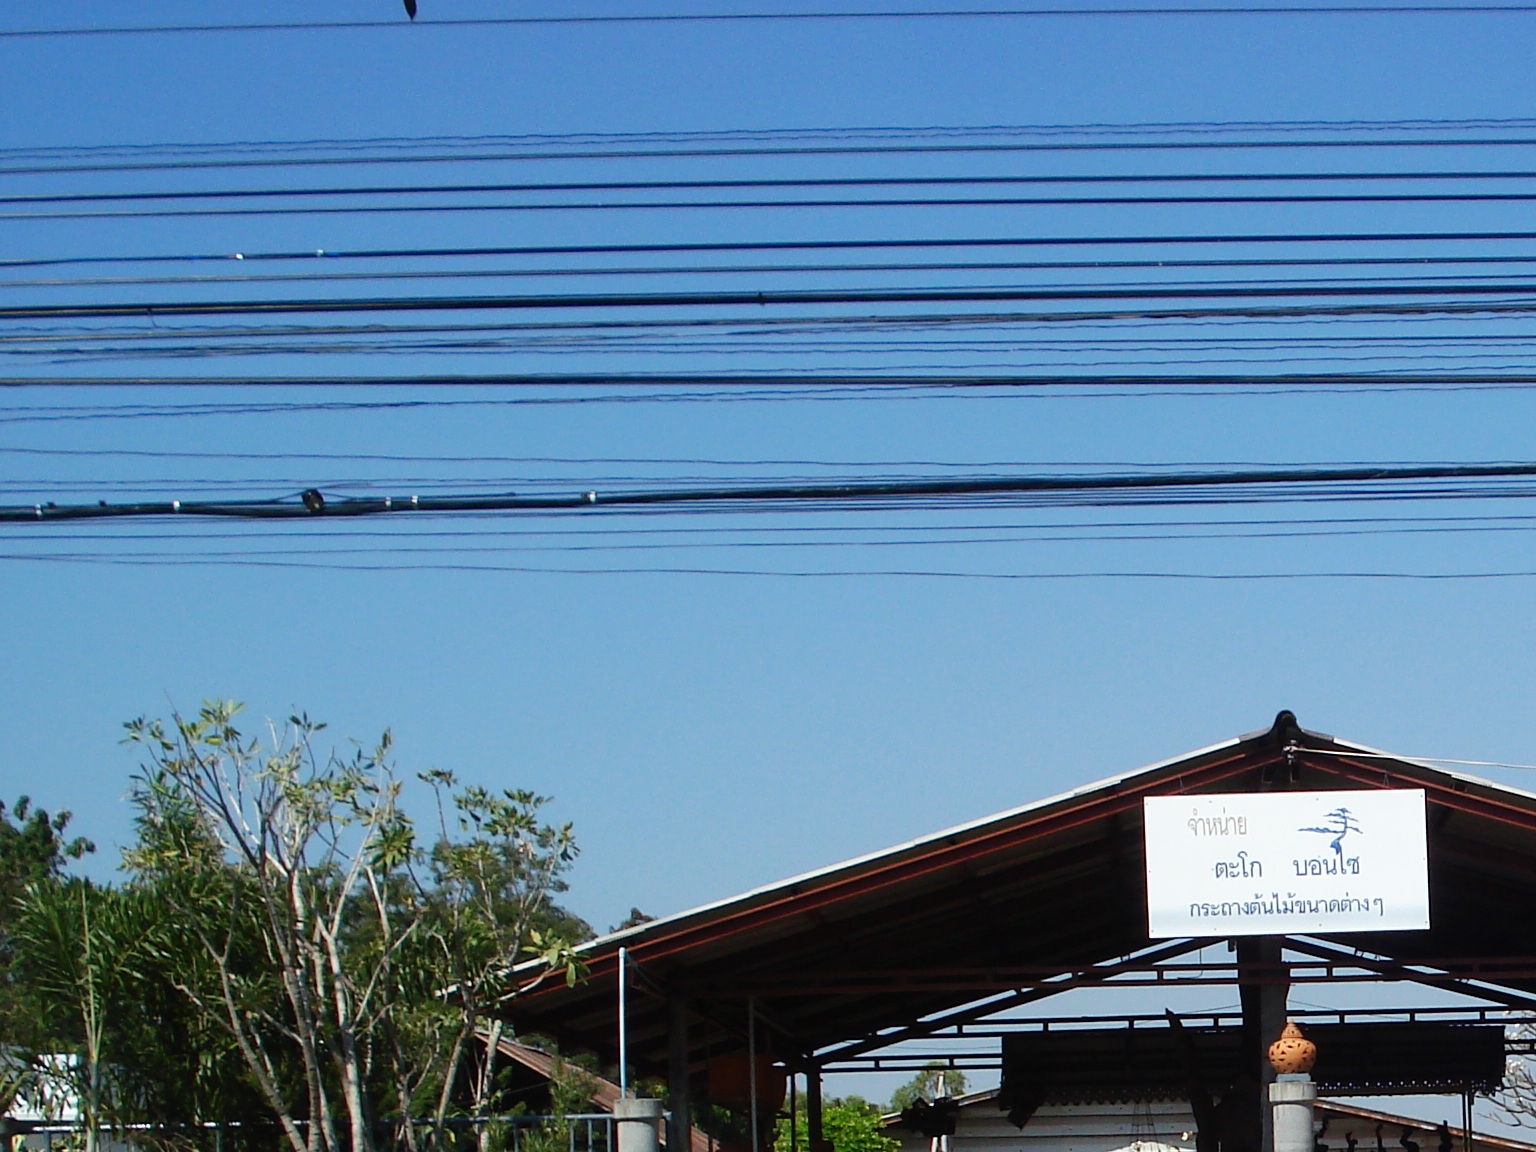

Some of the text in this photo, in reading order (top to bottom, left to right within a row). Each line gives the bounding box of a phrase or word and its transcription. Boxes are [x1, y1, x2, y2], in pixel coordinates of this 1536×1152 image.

[1187, 806, 1247, 836] จำหน่าย
[1215, 850, 1262, 878] ตะโก
